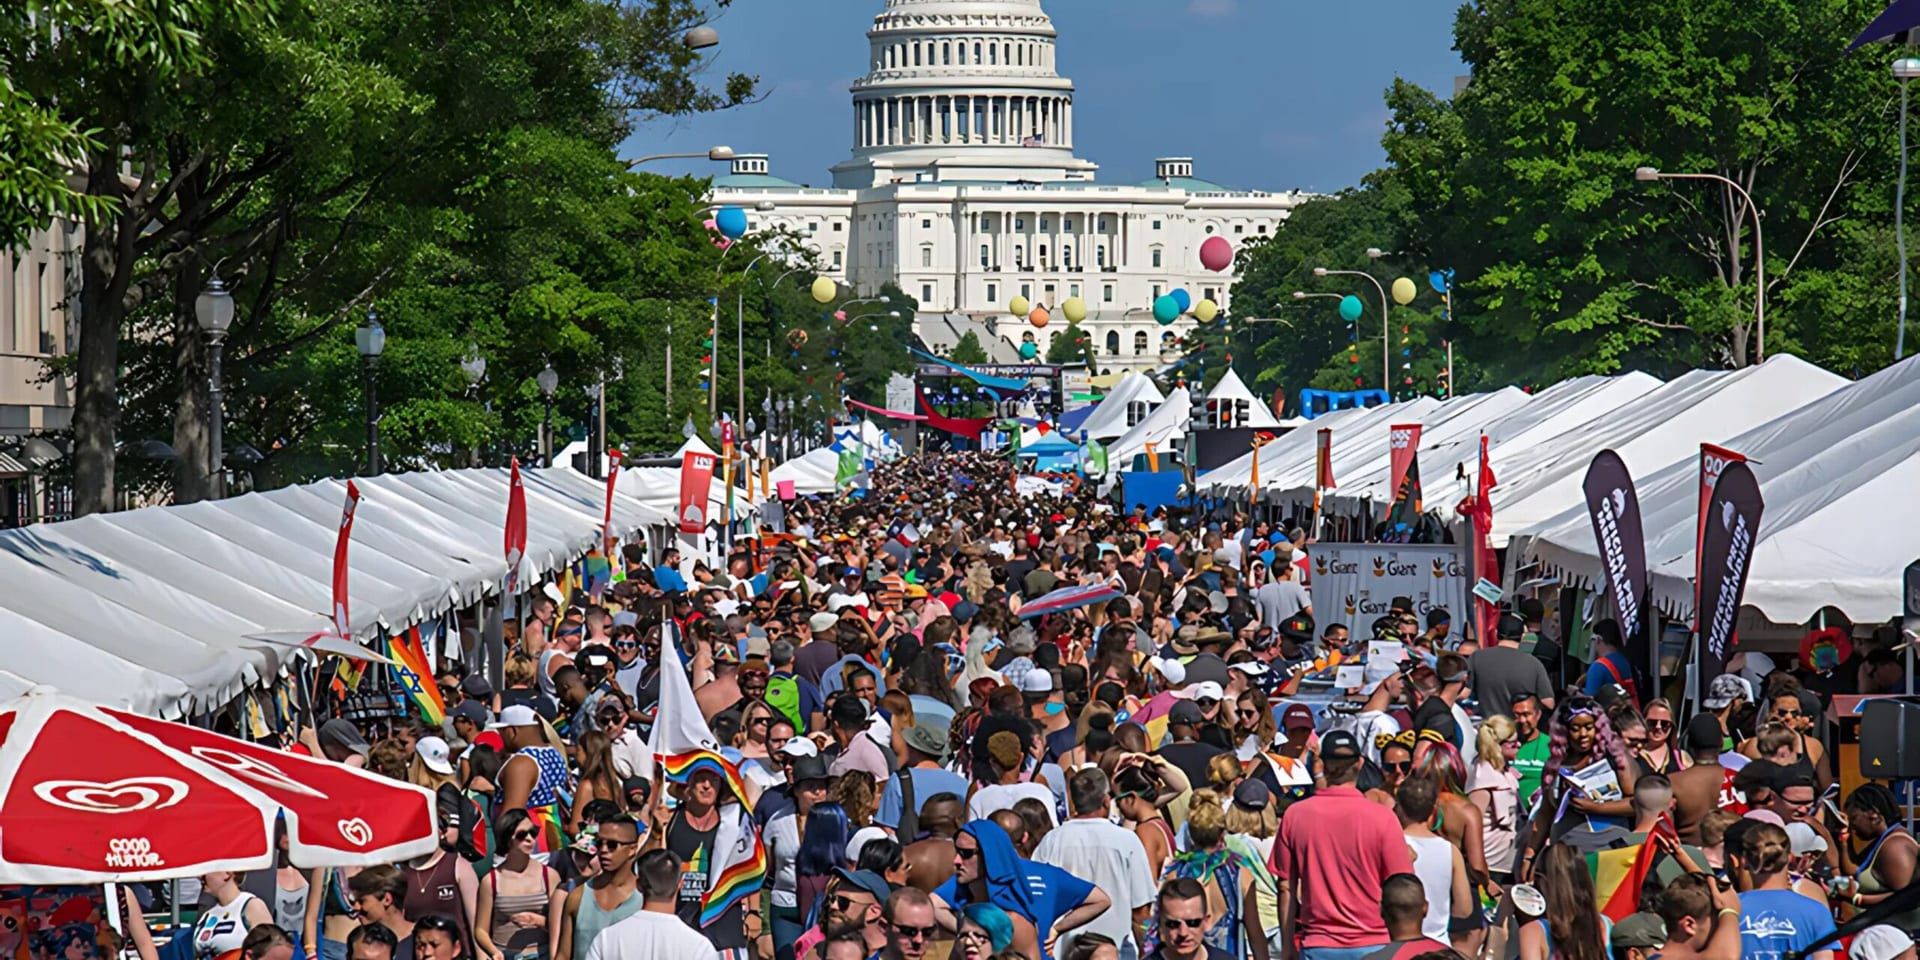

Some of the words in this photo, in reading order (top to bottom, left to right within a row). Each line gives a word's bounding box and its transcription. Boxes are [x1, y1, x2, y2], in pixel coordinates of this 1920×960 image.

[1387, 560, 1418, 576] Giant
[1602, 497, 1628, 574] OFFICIAL
[1708, 575, 1731, 652] OFFICIAL
[1726, 513, 1746, 571] PRIDE
[1714, 527, 1751, 661] MERCHANDISE
[109, 837, 151, 853] GOOD
